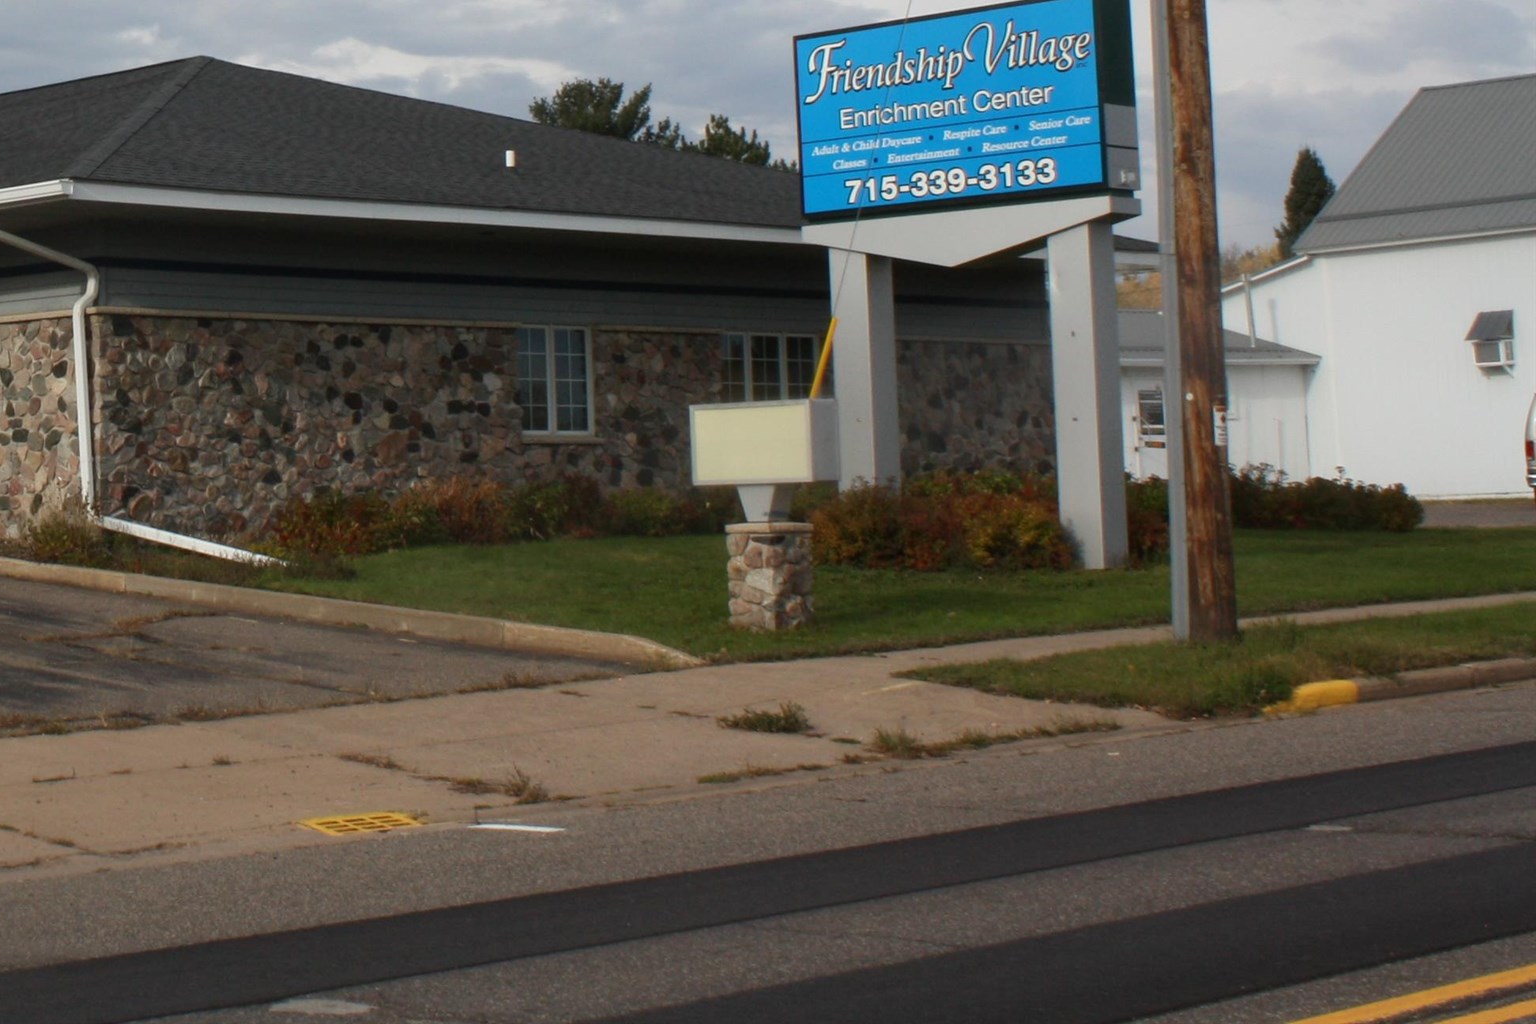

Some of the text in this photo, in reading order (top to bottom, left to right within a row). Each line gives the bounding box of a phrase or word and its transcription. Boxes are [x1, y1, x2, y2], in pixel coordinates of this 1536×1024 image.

[804, 18, 1090, 105] Friendship Village
[839, 85, 1054, 130] Enrichment Center
[811, 115, 1091, 156] Adult & Child Daycare Respite Care Senior Care
[833, 134, 1068, 170] Classes Entertainment Resource Center
[845, 157, 1057, 205] 715-339-3133
